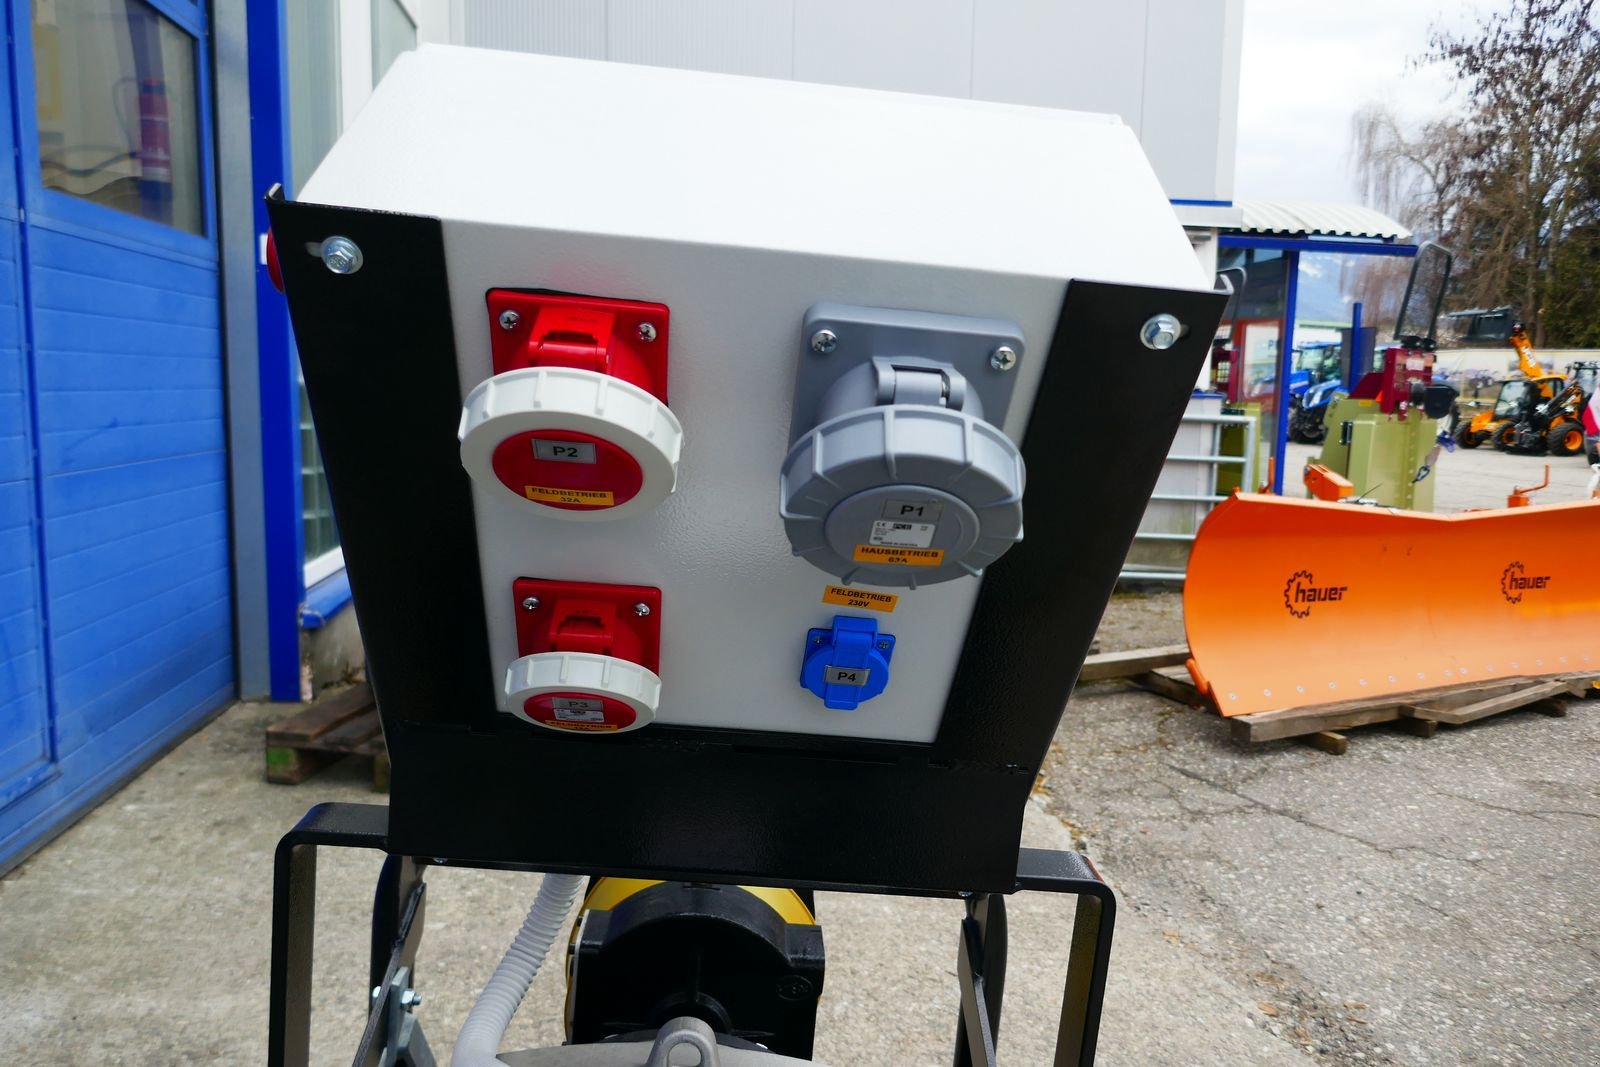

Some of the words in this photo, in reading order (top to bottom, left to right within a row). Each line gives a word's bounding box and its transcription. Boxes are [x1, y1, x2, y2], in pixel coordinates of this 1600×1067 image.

[553, 446, 578, 458] P2
[531, 487, 607, 499] FELDBETRIEB
[560, 496, 581, 504] 32A
[900, 505, 924, 517] P1
[861, 546, 939, 558] HAUSBETRIEB
[1509, 571, 1551, 590] hauer
[830, 587, 892, 603] FELDBETRIEB
[1294, 581, 1348, 603] hauer
[847, 599, 870, 608] 230V
[837, 671, 857, 682] P4
